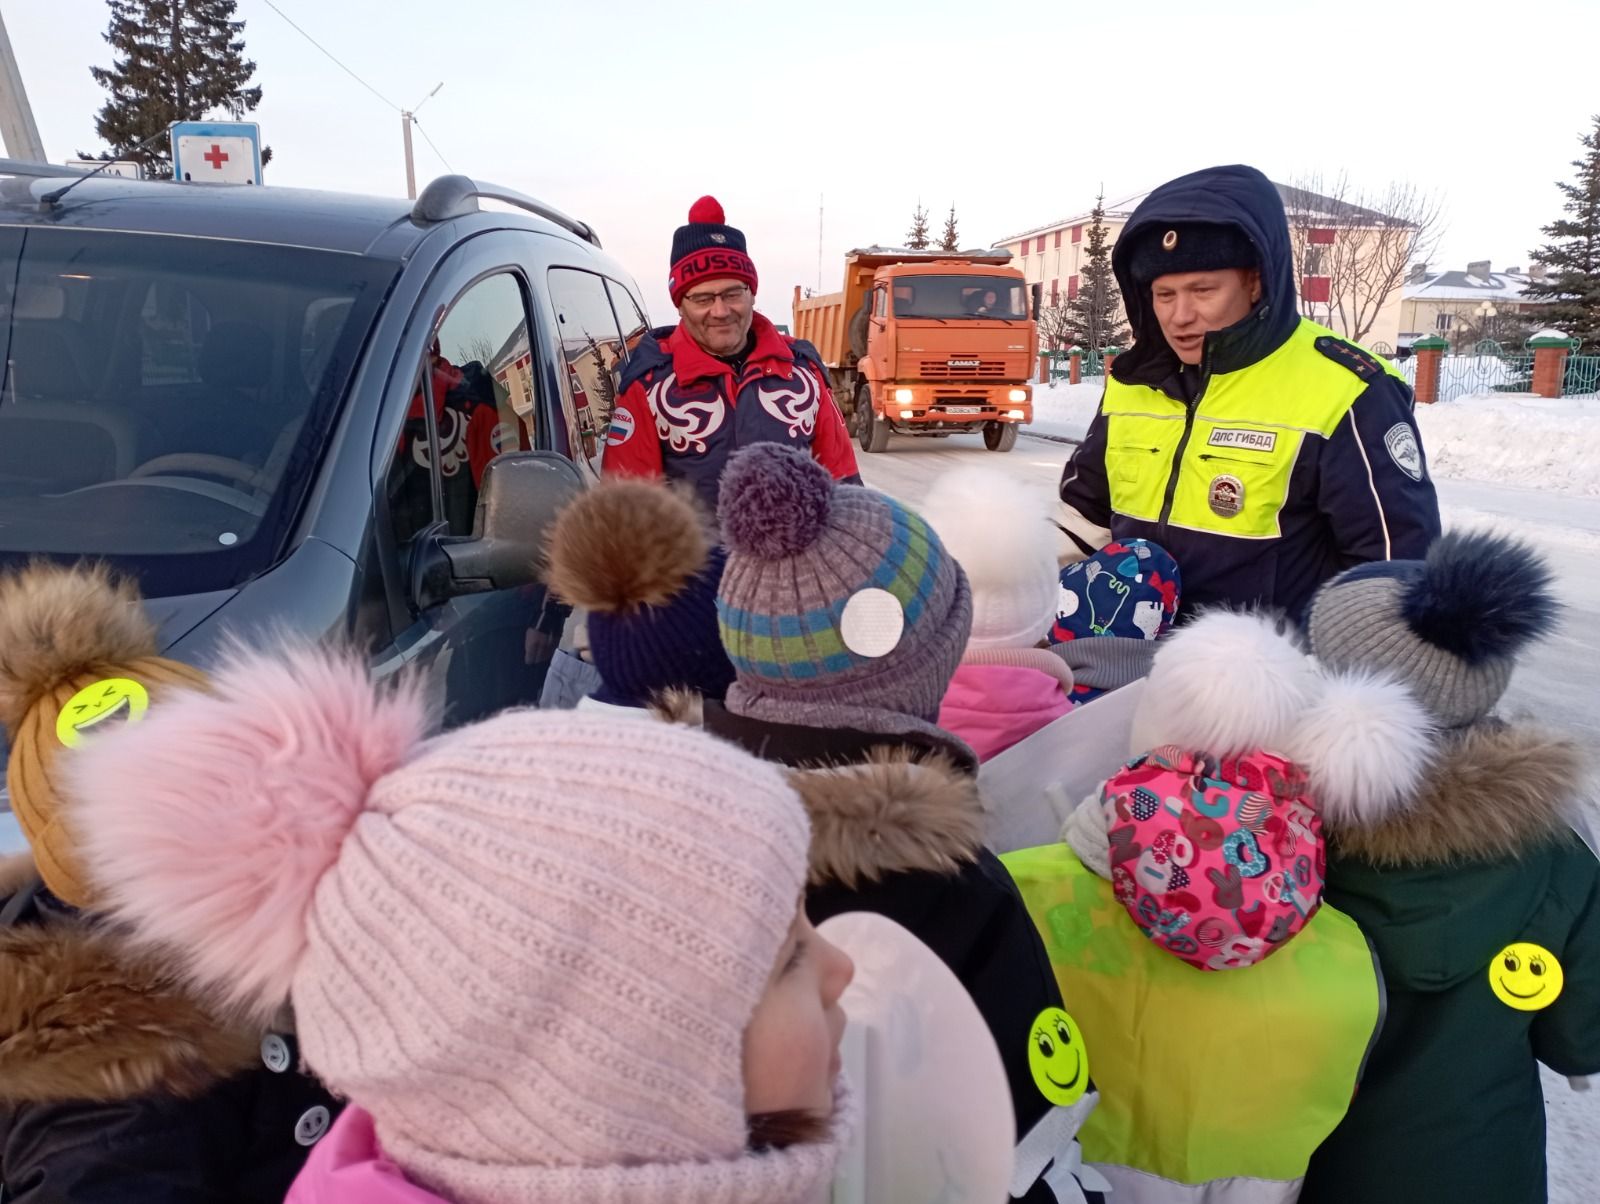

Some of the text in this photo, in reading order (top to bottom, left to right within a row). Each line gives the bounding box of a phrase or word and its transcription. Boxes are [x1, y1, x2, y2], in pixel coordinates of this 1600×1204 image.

[681, 254, 756, 281] RUSSIA
[1211, 431, 1272, 448] ДПС ГИБДД
